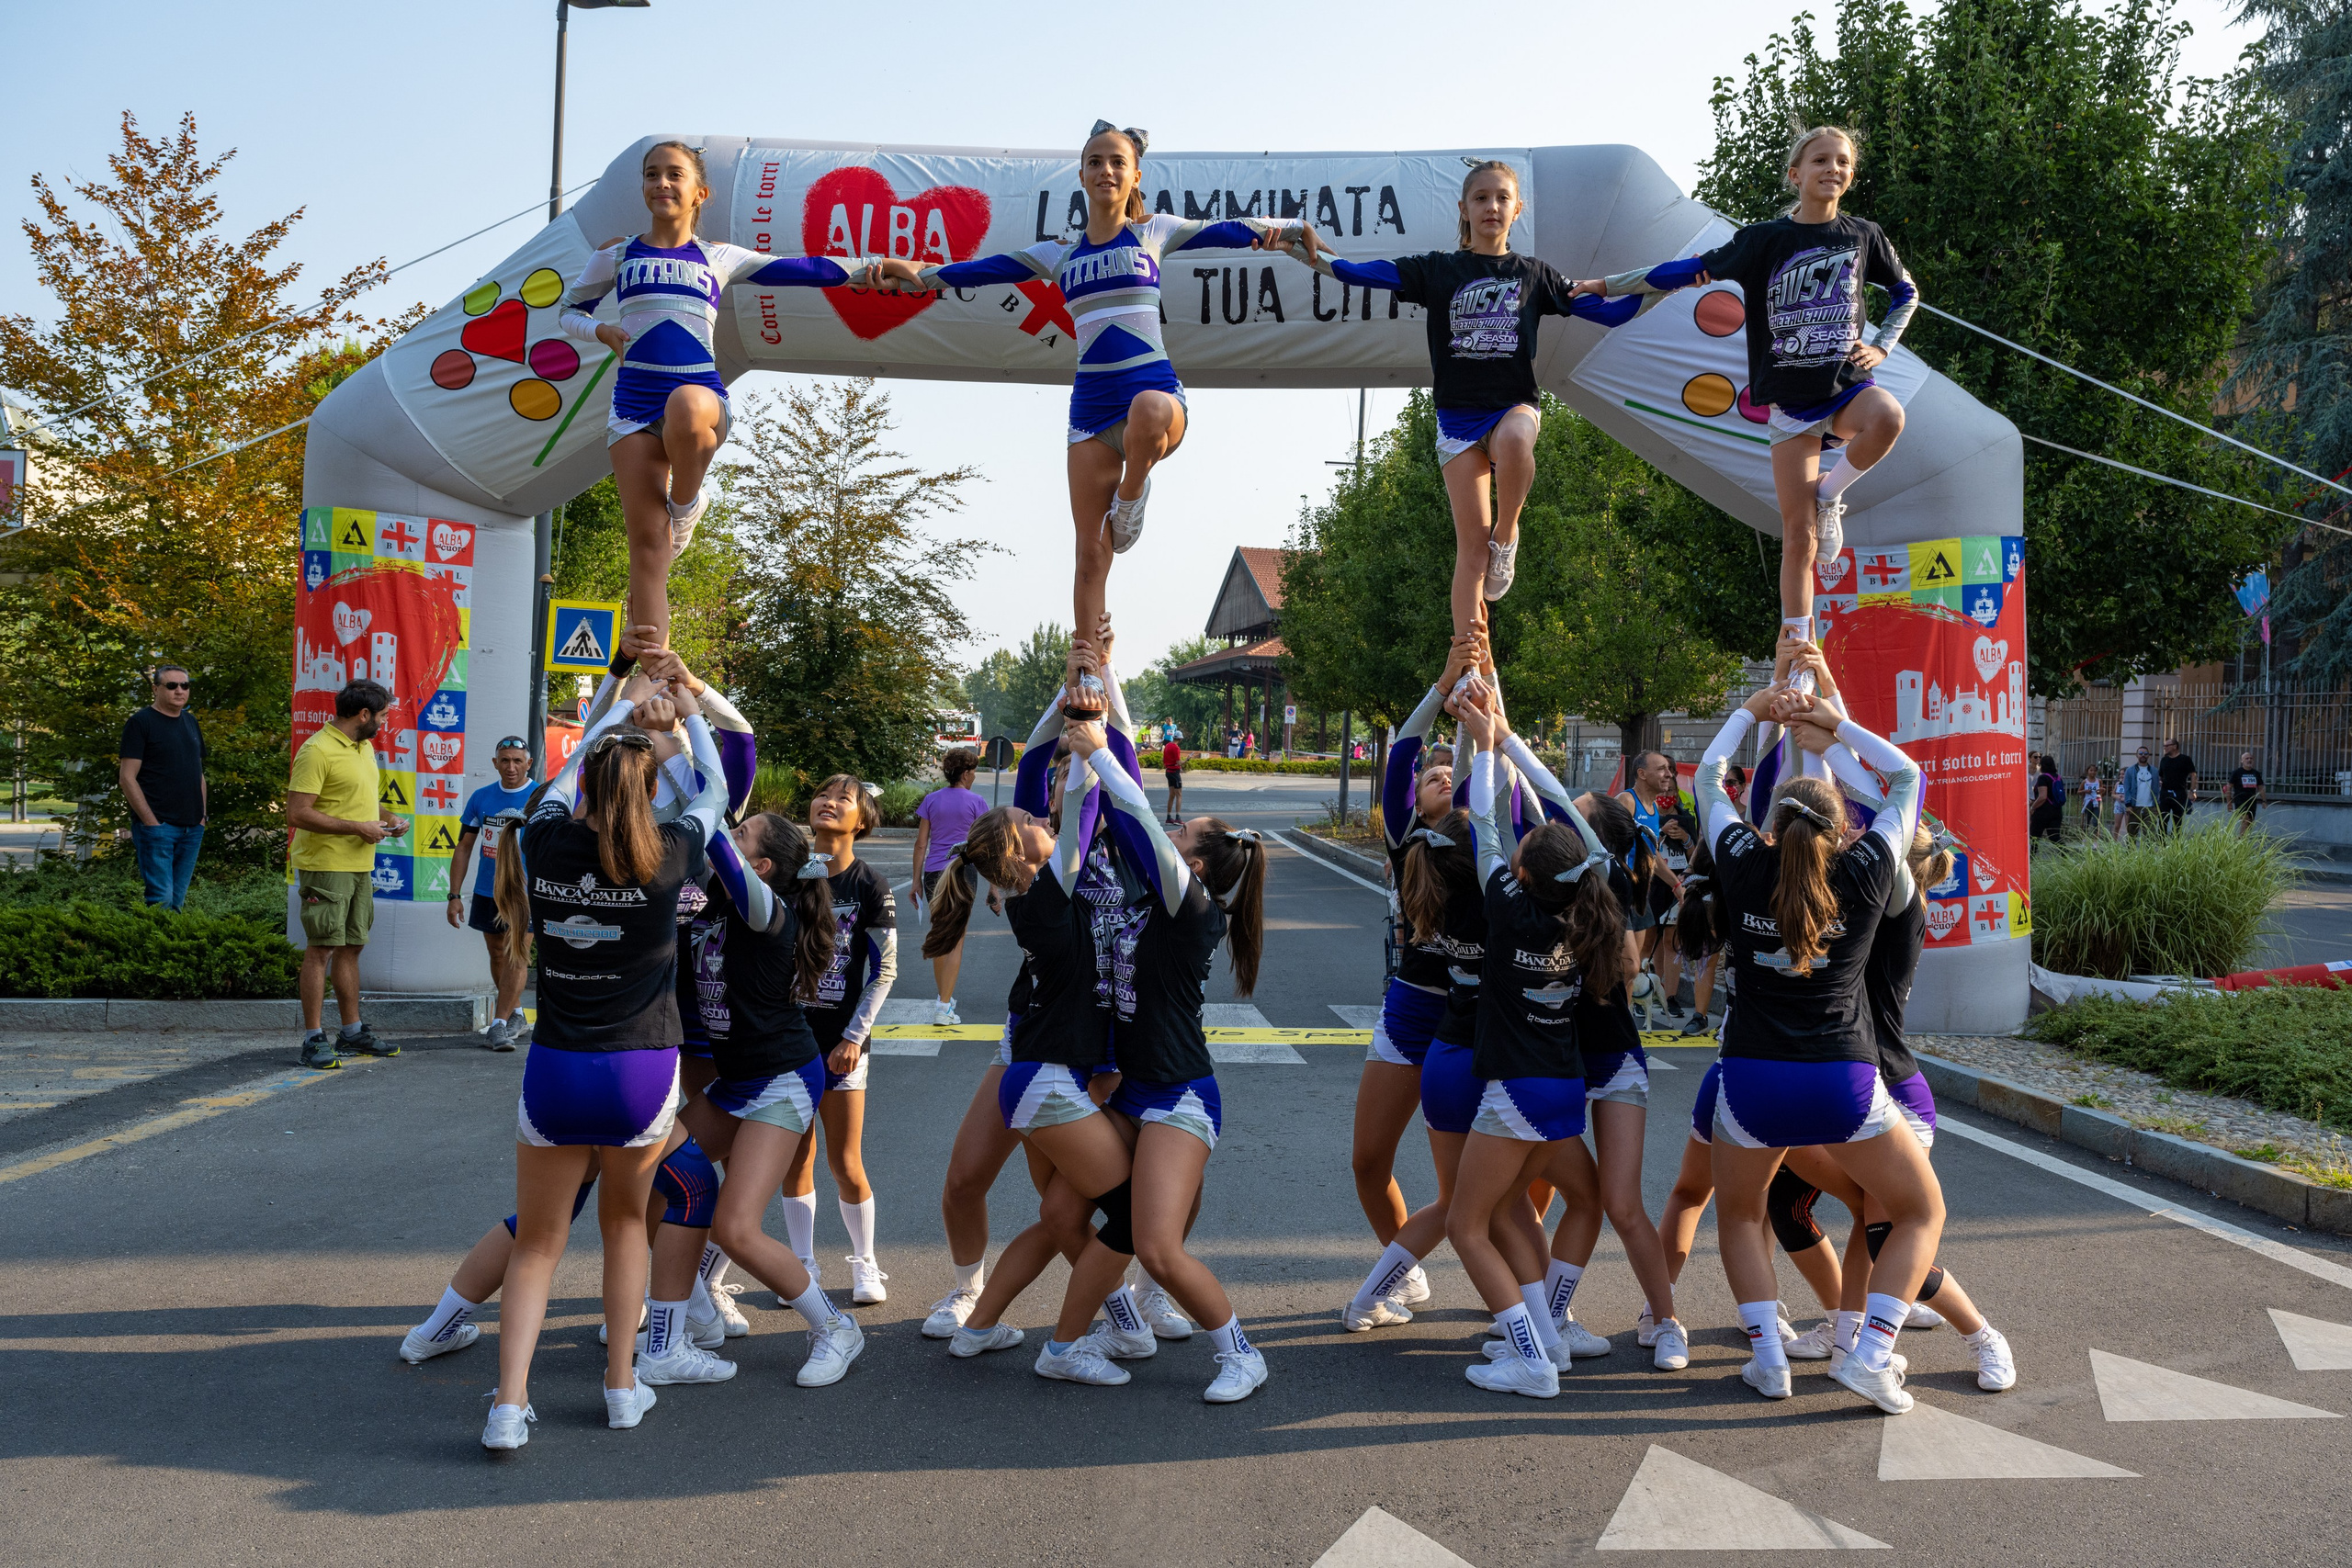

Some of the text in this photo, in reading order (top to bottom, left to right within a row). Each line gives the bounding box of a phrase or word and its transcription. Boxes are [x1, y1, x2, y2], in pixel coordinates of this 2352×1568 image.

[754, 162, 780, 199] torri
[752, 205, 773, 224] le
[1036, 190, 1089, 243] LA
[825, 203, 953, 266] ALBA
[619, 257, 715, 298] TITANS
[1062, 246, 1151, 293] TITANS
[1775, 250, 1860, 309] JUST
[1193, 265, 1285, 324] TUA
[1457, 281, 1519, 315] JUST
[754, 294, 782, 345] Corri
[1478, 334, 1519, 344] SEASON
[1808, 328, 1859, 342] SEASON
[438, 533, 463, 547] ALBA
[441, 544, 467, 553] cuore
[1821, 562, 1843, 575] ALBA
[1824, 573, 1849, 581] cuore
[338, 613, 363, 629] ALBA
[1980, 647, 2003, 662] ALBA
[428, 742, 454, 755] ALBA
[432, 753, 458, 761] cuore
[1942, 756, 1982, 771] sotto
[1985, 750, 1997, 767] le
[2000, 749, 2023, 765] torri
[1928, 772, 2012, 786] W.TRIANGOLOSPORT.IT
[1724, 829, 1743, 845] DANI
[534, 876, 649, 902] BANCA D'ALBA
[1743, 912, 1780, 931] BANC
[1929, 910, 1956, 924] ALBA
[1933, 921, 1961, 931] cuore
[1513, 948, 1555, 967] BANCA
[1272, 1030, 1374, 1039] Spor
[1376, 1265, 1408, 1297] TITANS
[1552, 1278, 1577, 1319] TITANS
[1109, 1296, 1135, 1332] TITANS
[437, 1311, 472, 1343] TITANS
[650, 1307, 668, 1354] TITANS
[1234, 1321, 1253, 1355] TITANS
[1512, 1315, 1537, 1360] TITANS
